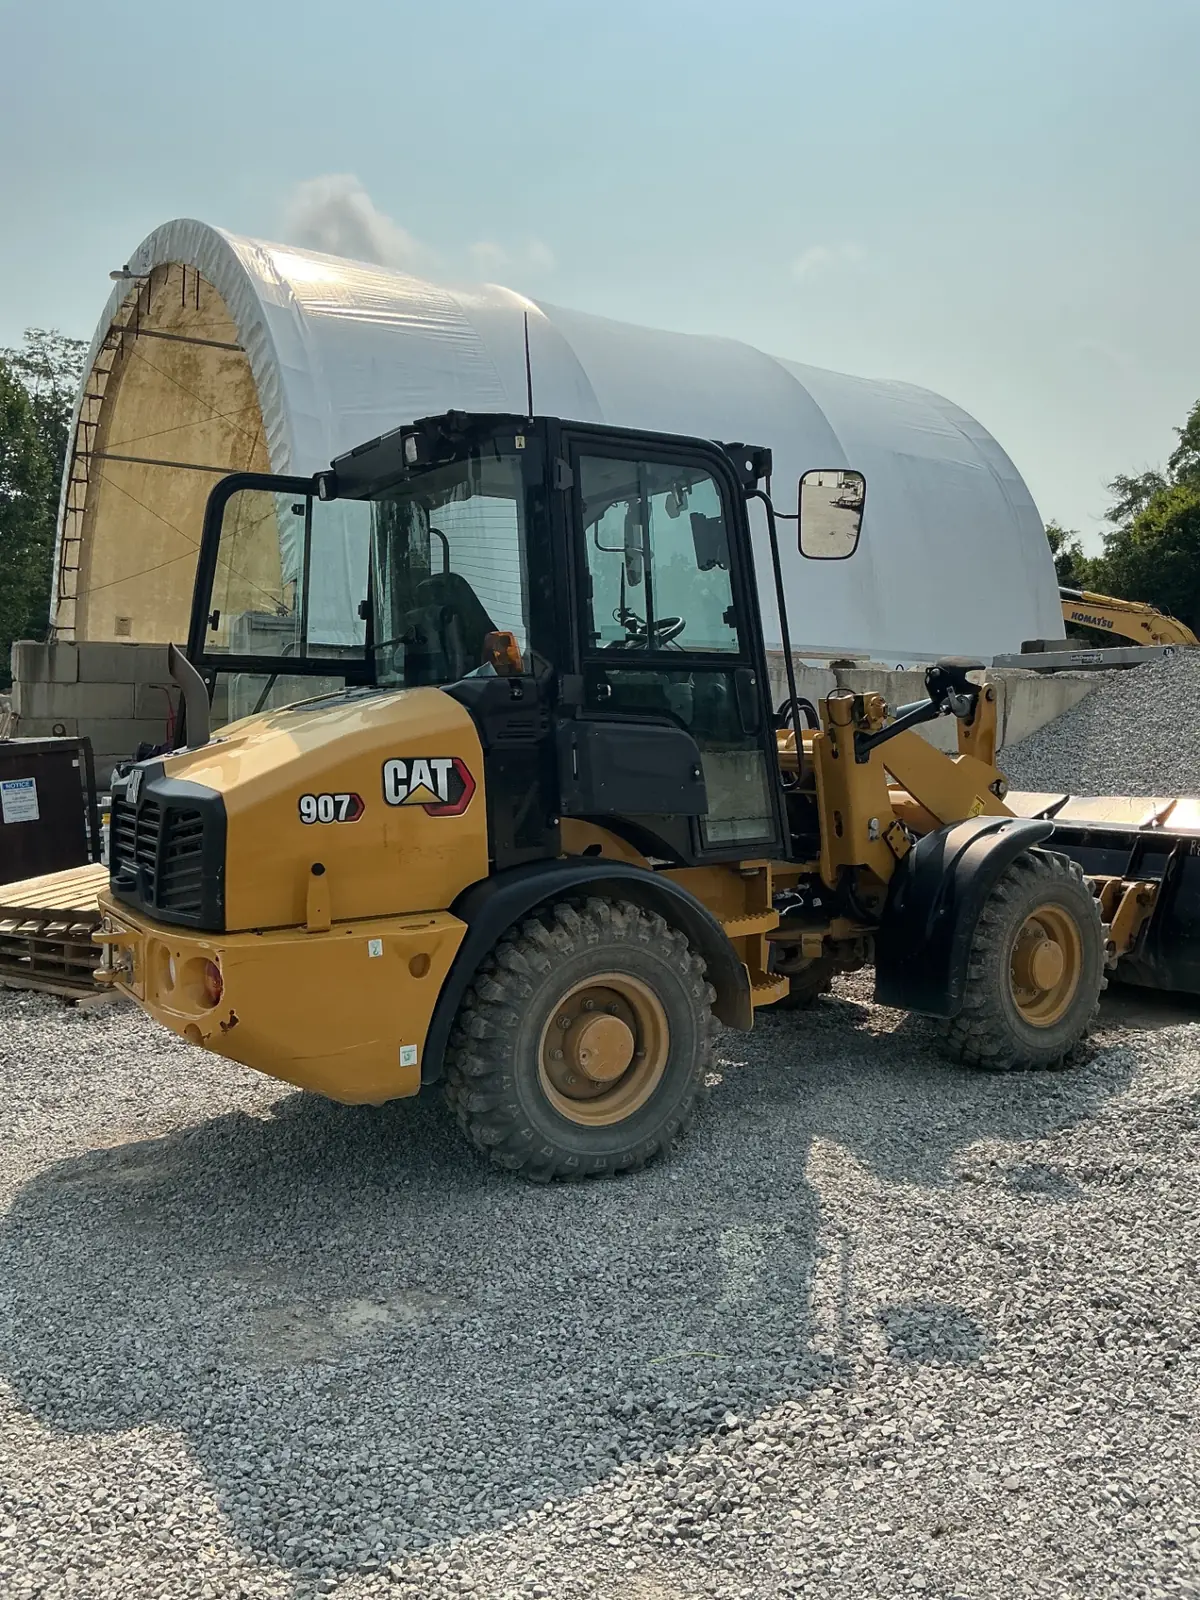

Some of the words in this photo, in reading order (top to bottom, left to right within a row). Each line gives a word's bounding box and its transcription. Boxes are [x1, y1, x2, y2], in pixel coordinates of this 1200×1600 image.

[1071, 611, 1114, 629] KOMATSU
[5, 781, 30, 789] NOTICE
[383, 758, 453, 805] CAT
[300, 795, 351, 823] 907
